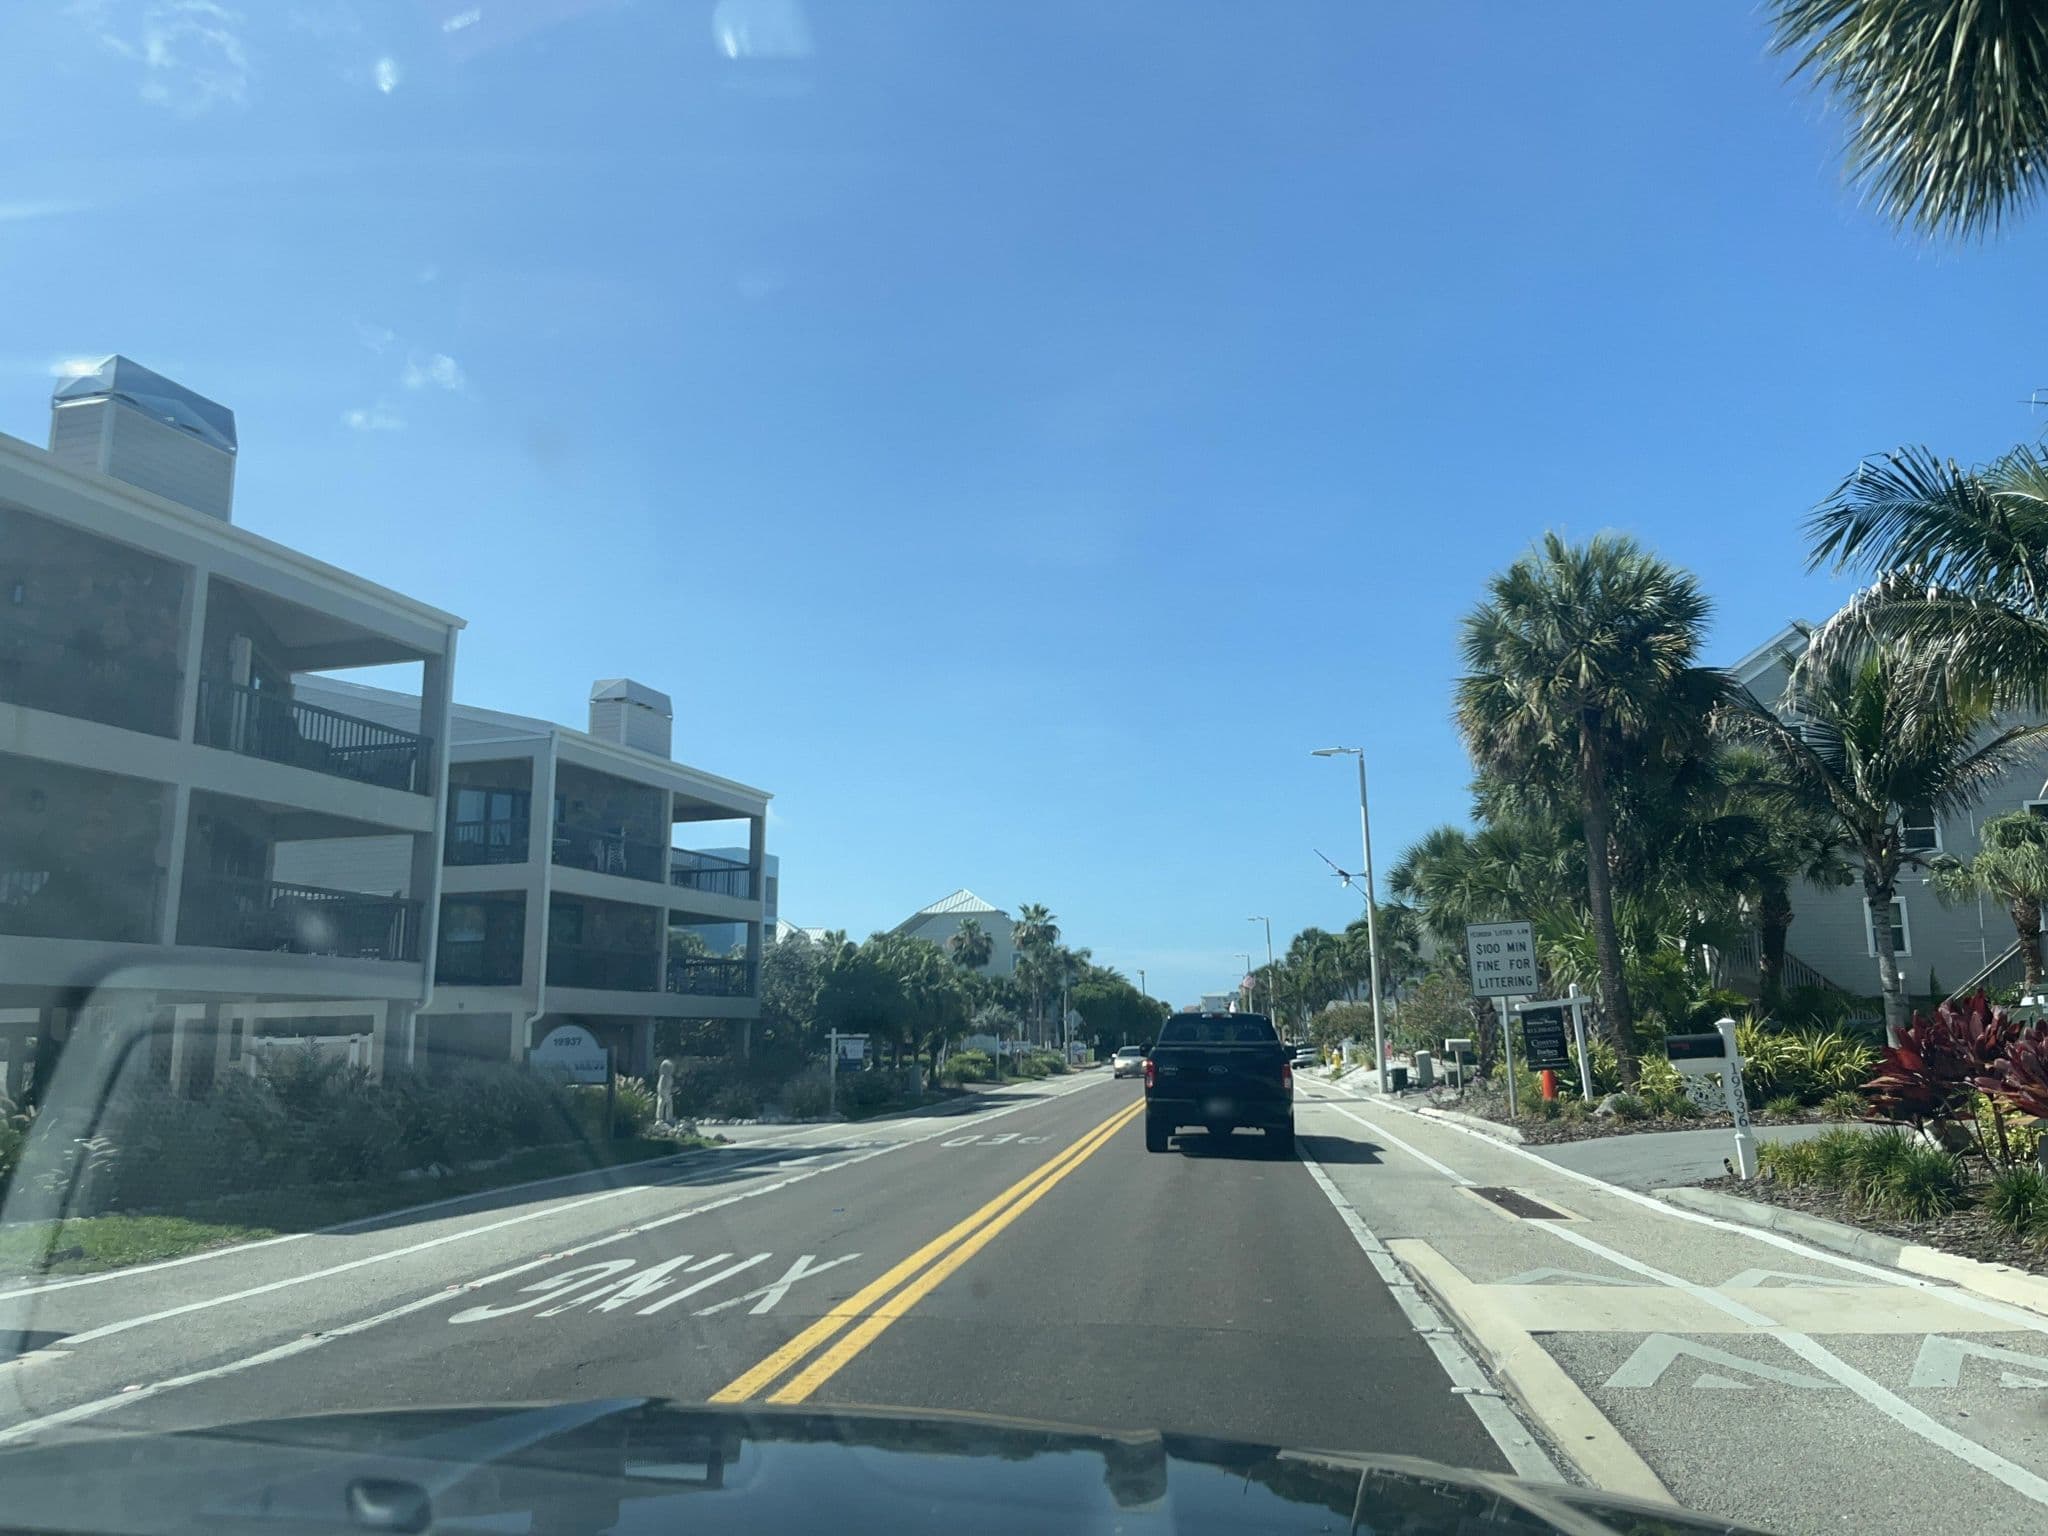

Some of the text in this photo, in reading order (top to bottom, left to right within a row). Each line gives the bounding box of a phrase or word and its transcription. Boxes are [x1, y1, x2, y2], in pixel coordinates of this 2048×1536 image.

[1476, 941, 1527, 955] $100 MIN
[1476, 958, 1531, 972] FINE FOR
[1478, 975, 1533, 989] LITTERING
[1731, 1062, 1748, 1127] 19936
